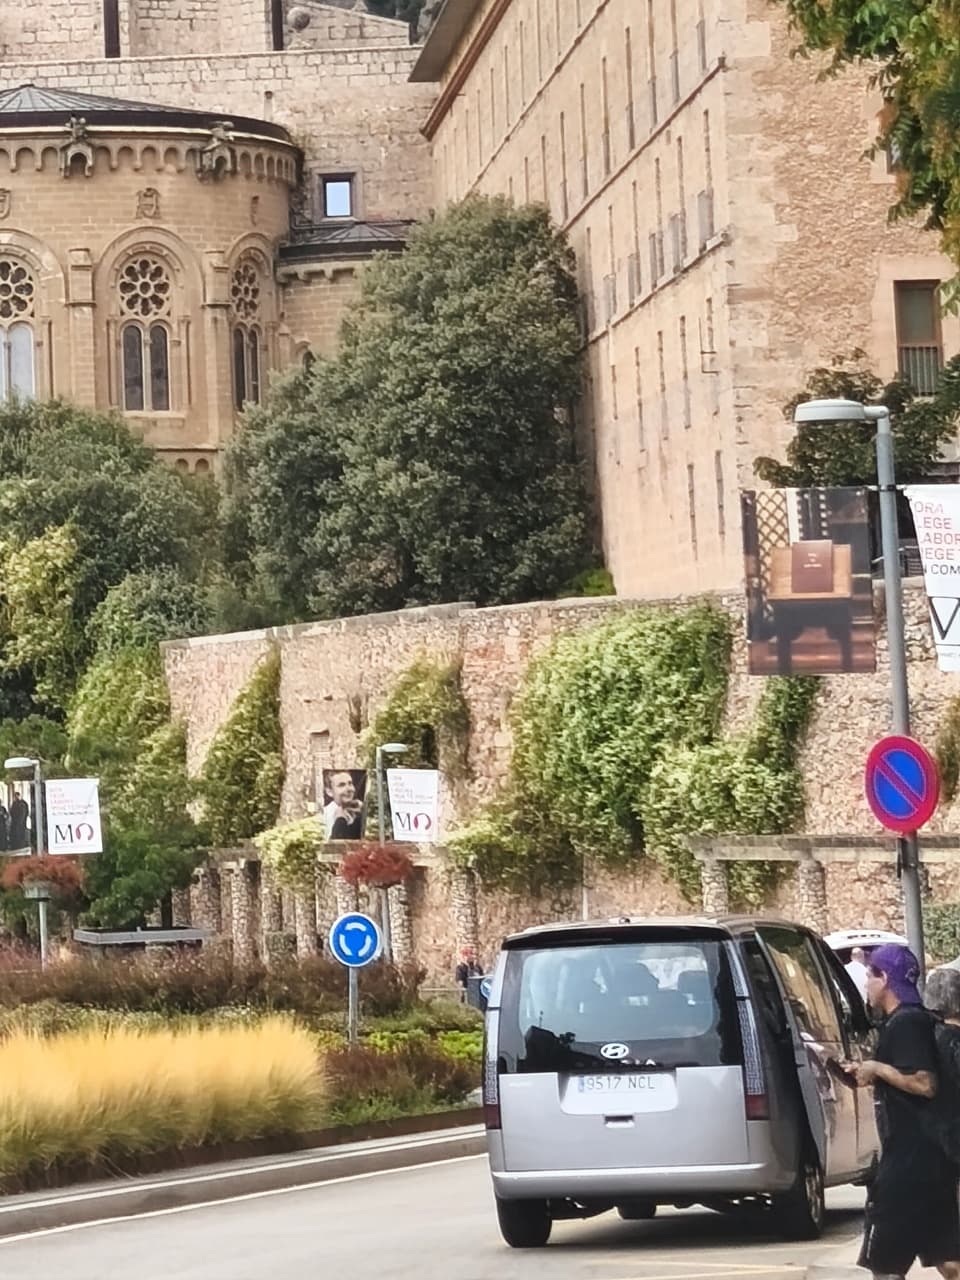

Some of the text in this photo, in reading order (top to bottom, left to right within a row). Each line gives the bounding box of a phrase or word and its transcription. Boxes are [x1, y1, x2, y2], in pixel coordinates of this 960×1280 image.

[914, 501, 944, 514] ORA
[921, 547, 954, 561] EGE
[586, 1075, 656, 1090] 9517 NCL
